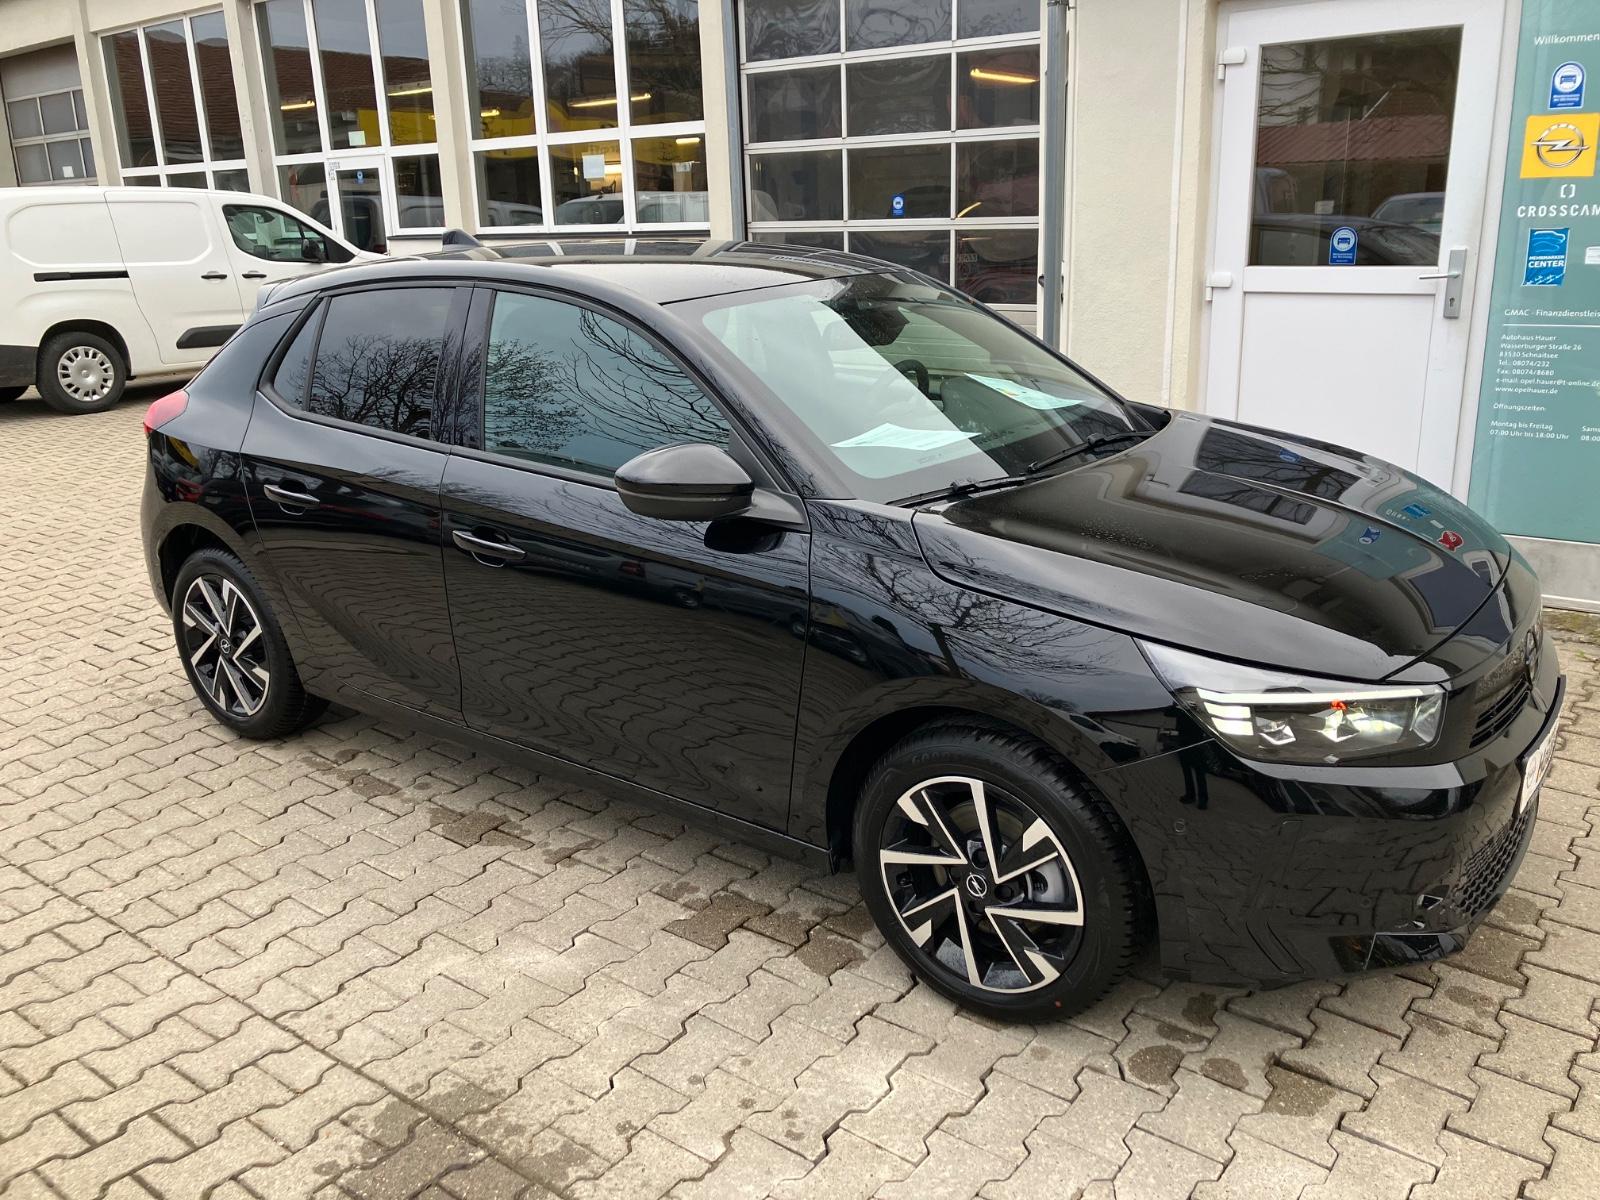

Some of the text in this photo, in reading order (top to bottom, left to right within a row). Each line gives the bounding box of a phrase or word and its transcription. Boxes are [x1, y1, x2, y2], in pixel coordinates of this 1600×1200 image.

[1534, 32, 1600, 45] Willkommen
[1528, 260, 1565, 268] CENTER
[1504, 309, 1530, 317] GMAC
[1500, 343, 1547, 351] Wasserburger
[1495, 386, 1559, 395] www.opelhauer.de
[1490, 420, 1517, 429] Montag
[1529, 422, 1553, 431] Freitag
[1556, 432, 1569, 440] Uhr
